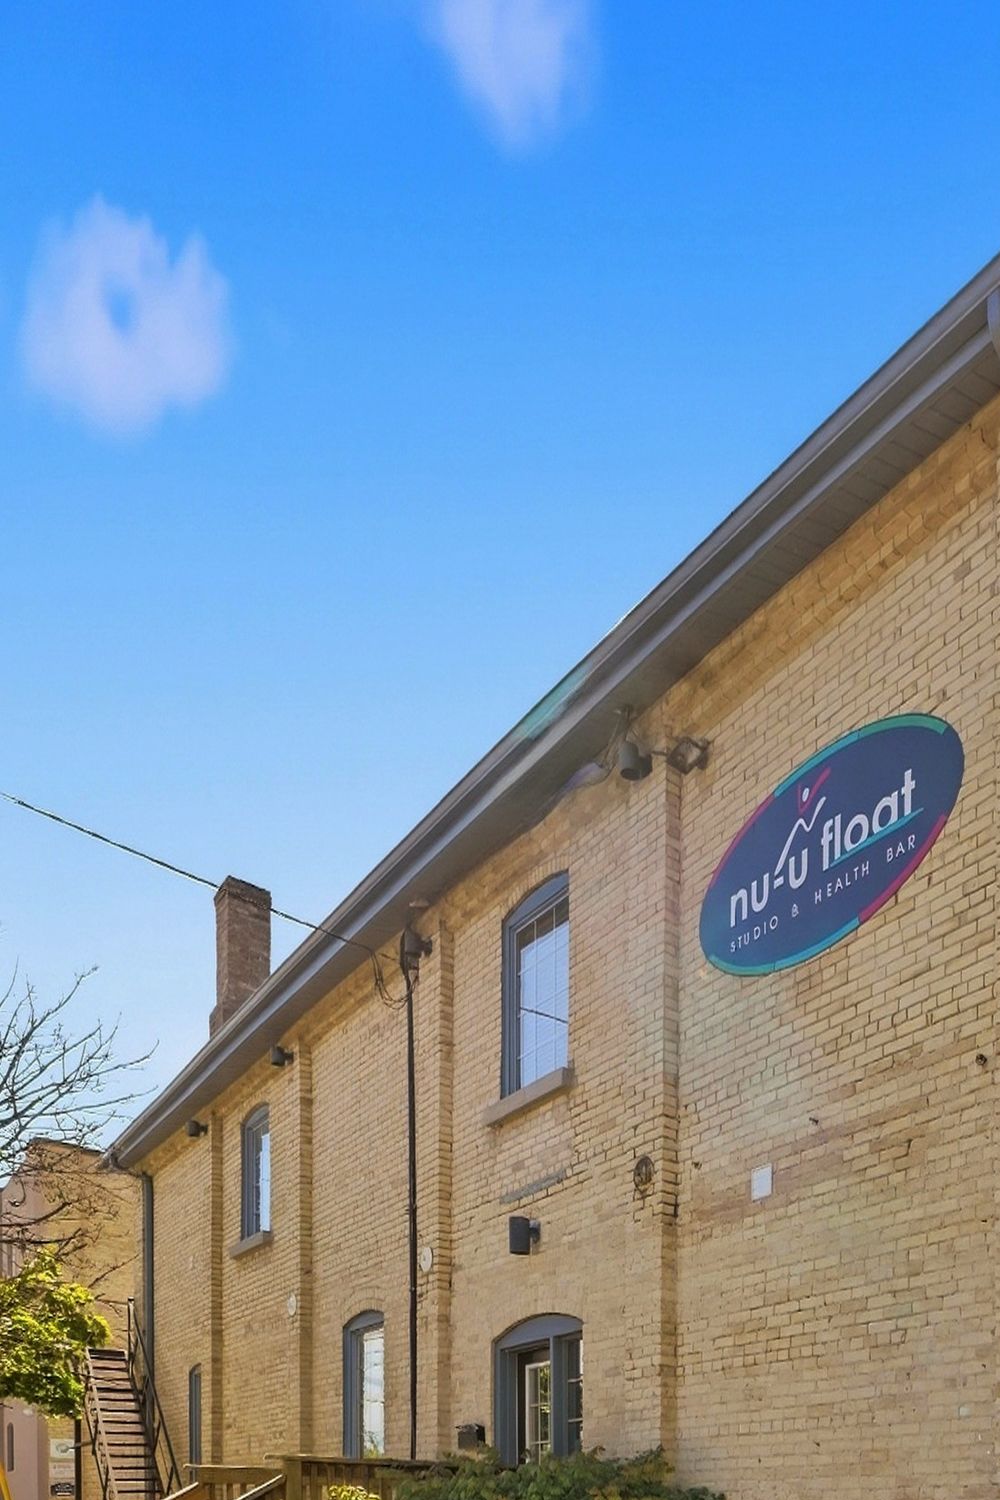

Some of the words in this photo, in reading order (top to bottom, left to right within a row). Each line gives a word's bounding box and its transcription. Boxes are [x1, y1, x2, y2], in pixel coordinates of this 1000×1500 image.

[730, 847, 809, 928] nu-u
[820, 768, 916, 871] float
[730, 916, 778, 952] STUDIO
[814, 862, 870, 904] HEALTH
[886, 834, 916, 862] BAR
